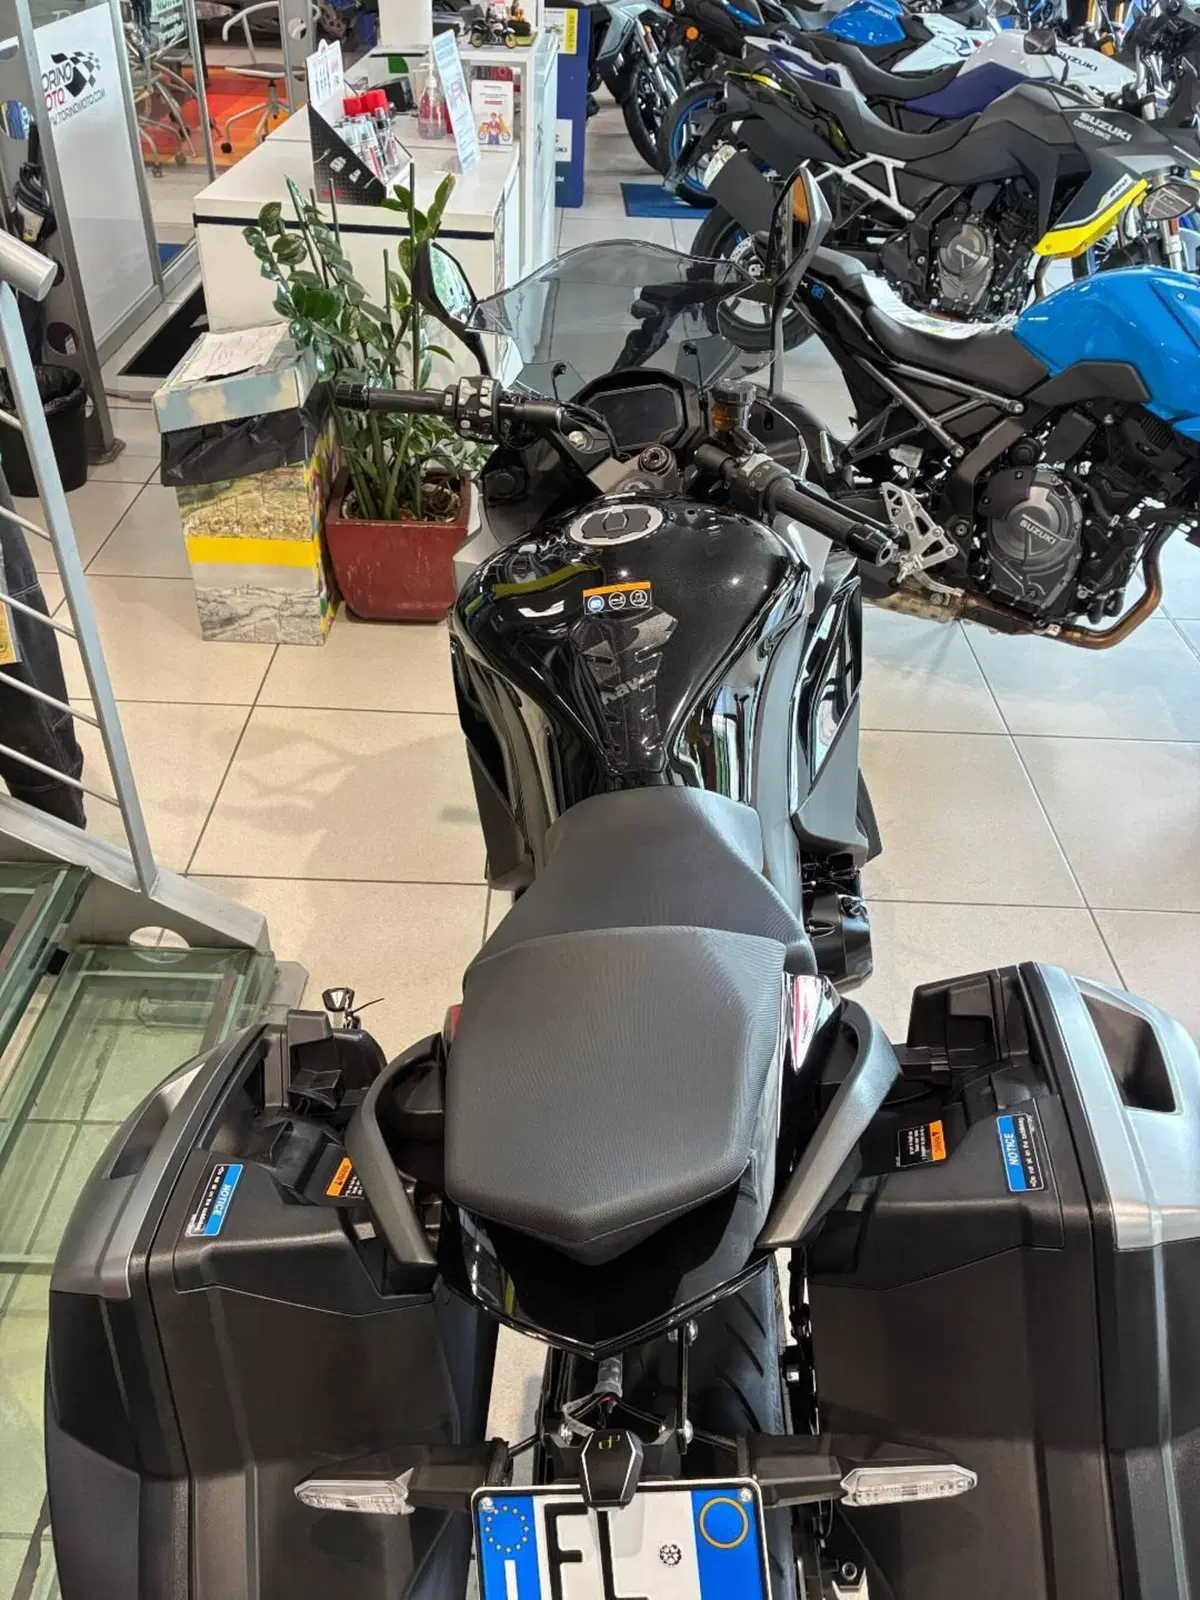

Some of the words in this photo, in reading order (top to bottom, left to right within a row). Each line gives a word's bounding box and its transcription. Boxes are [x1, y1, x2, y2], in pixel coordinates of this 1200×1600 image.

[41, 62, 72, 92] ORINO
[45, 87, 65, 112] OTO
[1073, 119, 1096, 133] DEMO
[1094, 128, 1112, 141] BIKE
[1079, 112, 1132, 142] SUZUKI
[1020, 519, 1056, 544] SUZUKI
[1003, 1133, 1020, 1165] NOTICE
[212, 1184, 231, 1216] NOTICE
